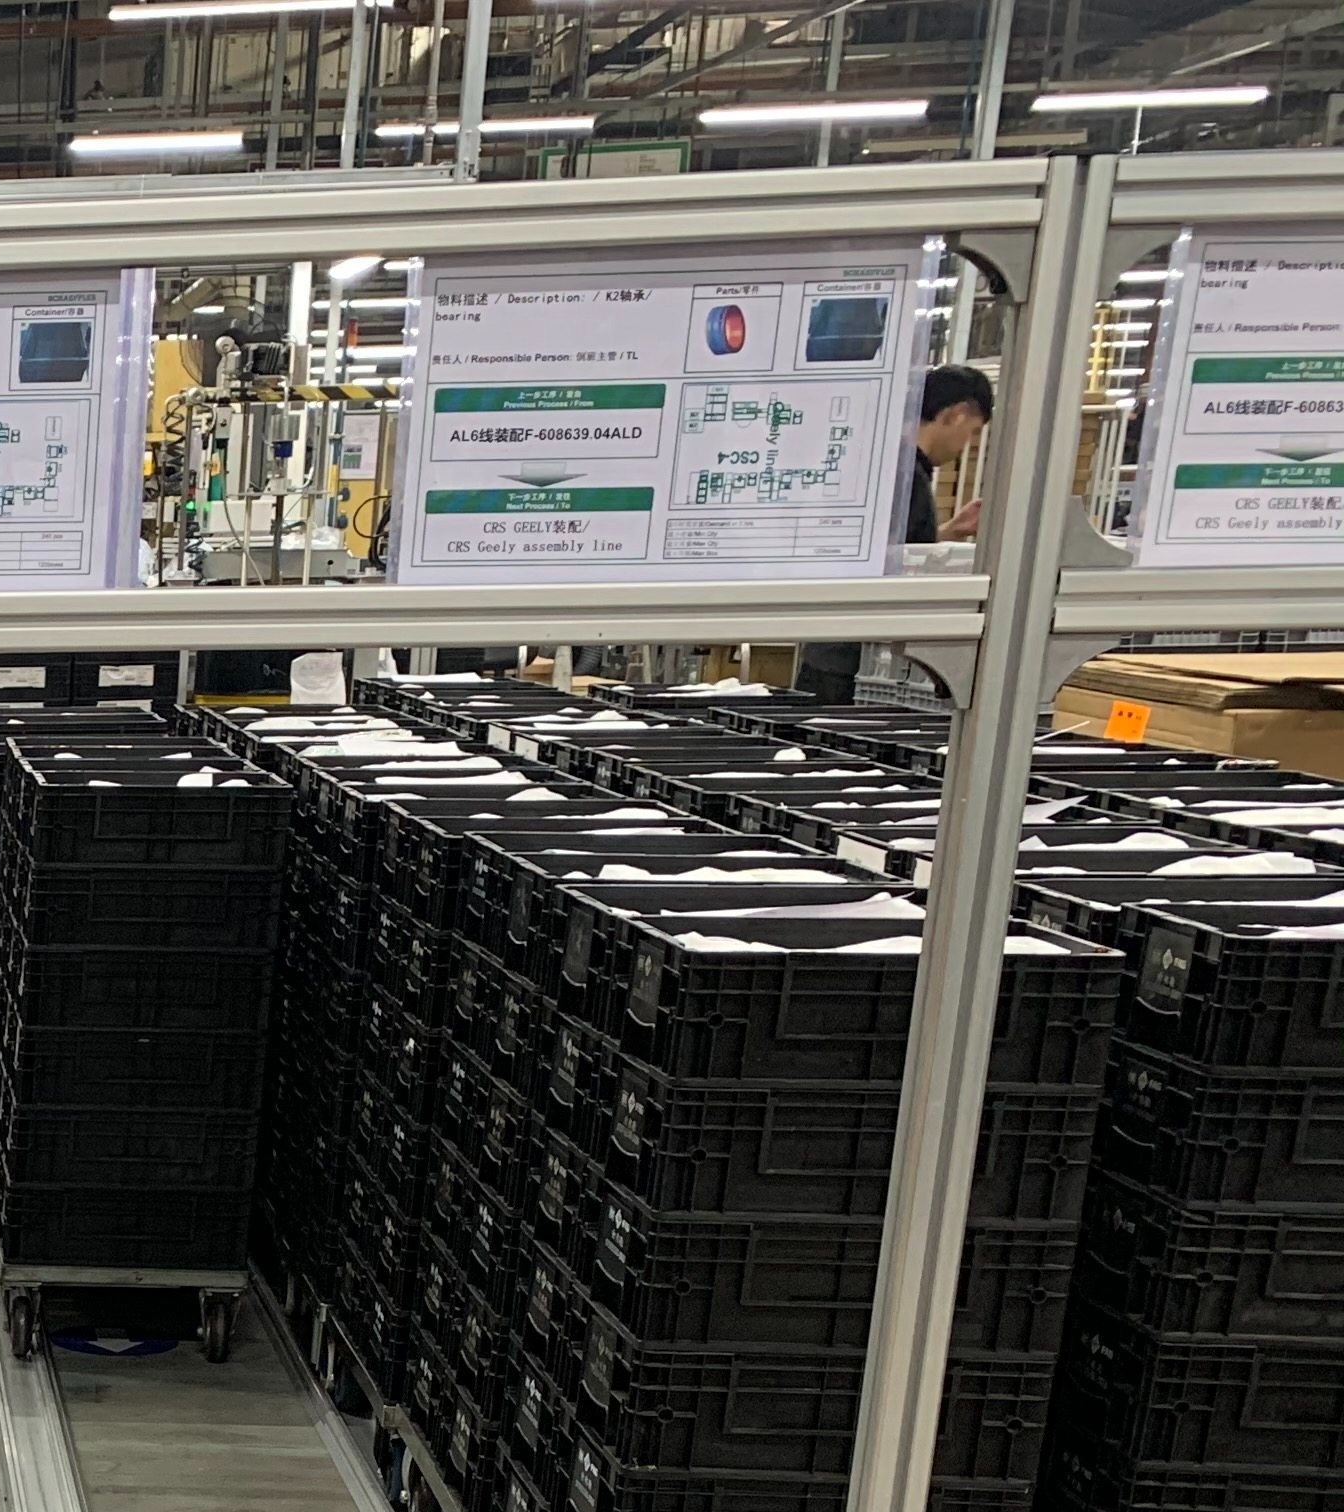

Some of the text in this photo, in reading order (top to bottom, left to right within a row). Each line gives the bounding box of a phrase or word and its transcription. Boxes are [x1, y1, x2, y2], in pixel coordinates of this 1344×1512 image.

[1200, 279, 1249, 289] bearing
[437, 292, 488, 307] 物料描述
[606, 289, 651, 302] K2轴承/
[435, 311, 481, 322] bearing
[1234, 323, 1299, 334] Responsible
[432, 354, 462, 365] 责任人
[470, 353, 531, 365] Responsible
[626, 351, 638, 360] TL
[503, 401, 536, 409] Previous
[537, 400, 568, 408] Process
[1203, 400, 1344, 415] AL6线装配F-60863
[450, 426, 642, 443] AL6线装配F-608639.04ALD
[1235, 496, 1344, 510] CRS GEELY装配
[483, 520, 590, 534] CRS GEELY装配/
[1195, 516, 1343, 530] CRS Geely assembly
[447, 539, 622, 554] CRS Geely assembly line
